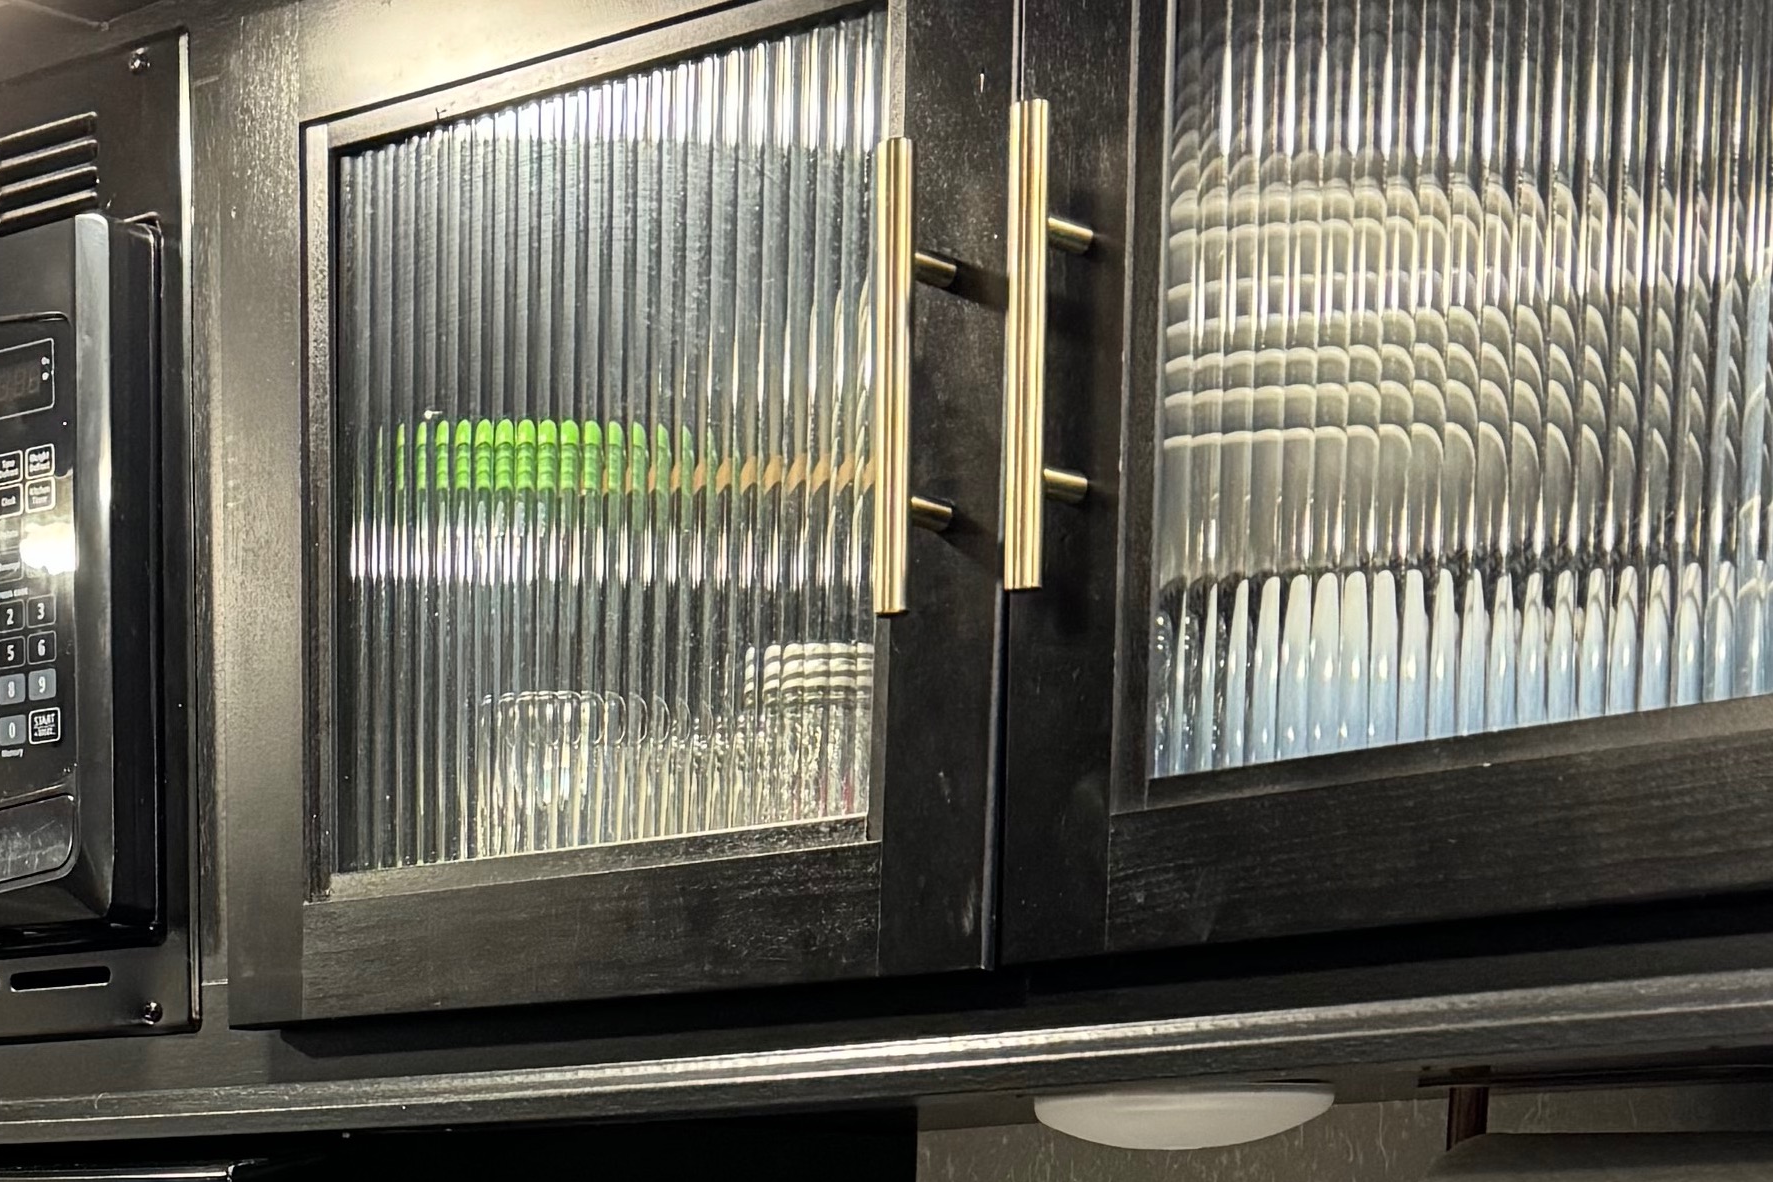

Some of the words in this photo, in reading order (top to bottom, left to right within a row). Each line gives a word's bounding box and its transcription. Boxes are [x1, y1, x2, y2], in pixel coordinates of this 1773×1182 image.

[7, 609, 14, 626] 2
[37, 603, 45, 620] 3
[7, 645, 14, 661] 5
[38, 639, 45, 656] 6
[8, 681, 15, 698] 8
[38, 676, 45, 693] 9
[34, 714, 55, 726] START
[9, 722, 16, 739] 0
